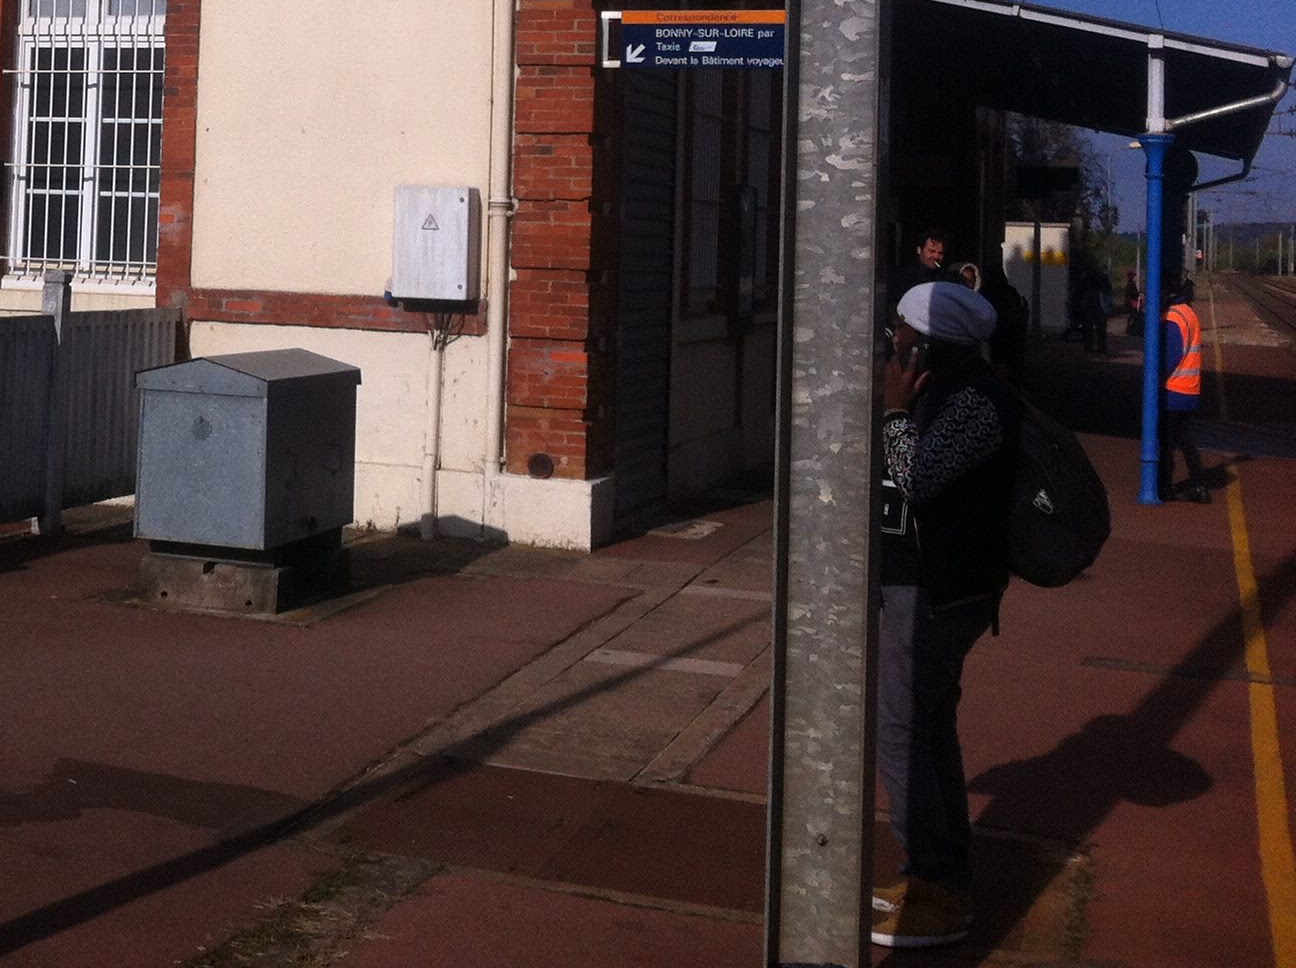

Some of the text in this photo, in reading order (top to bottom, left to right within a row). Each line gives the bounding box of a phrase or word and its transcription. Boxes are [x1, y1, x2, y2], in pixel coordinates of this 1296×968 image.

[656, 13, 738, 23] Correspondance
[655, 28, 775, 40] BONNY-SUR-LOIRE par
[656, 41, 681, 52] Taxis
[655, 55, 688, 66] Devant
[690, 55, 699, 66] le
[702, 55, 744, 66] Bâtiment
